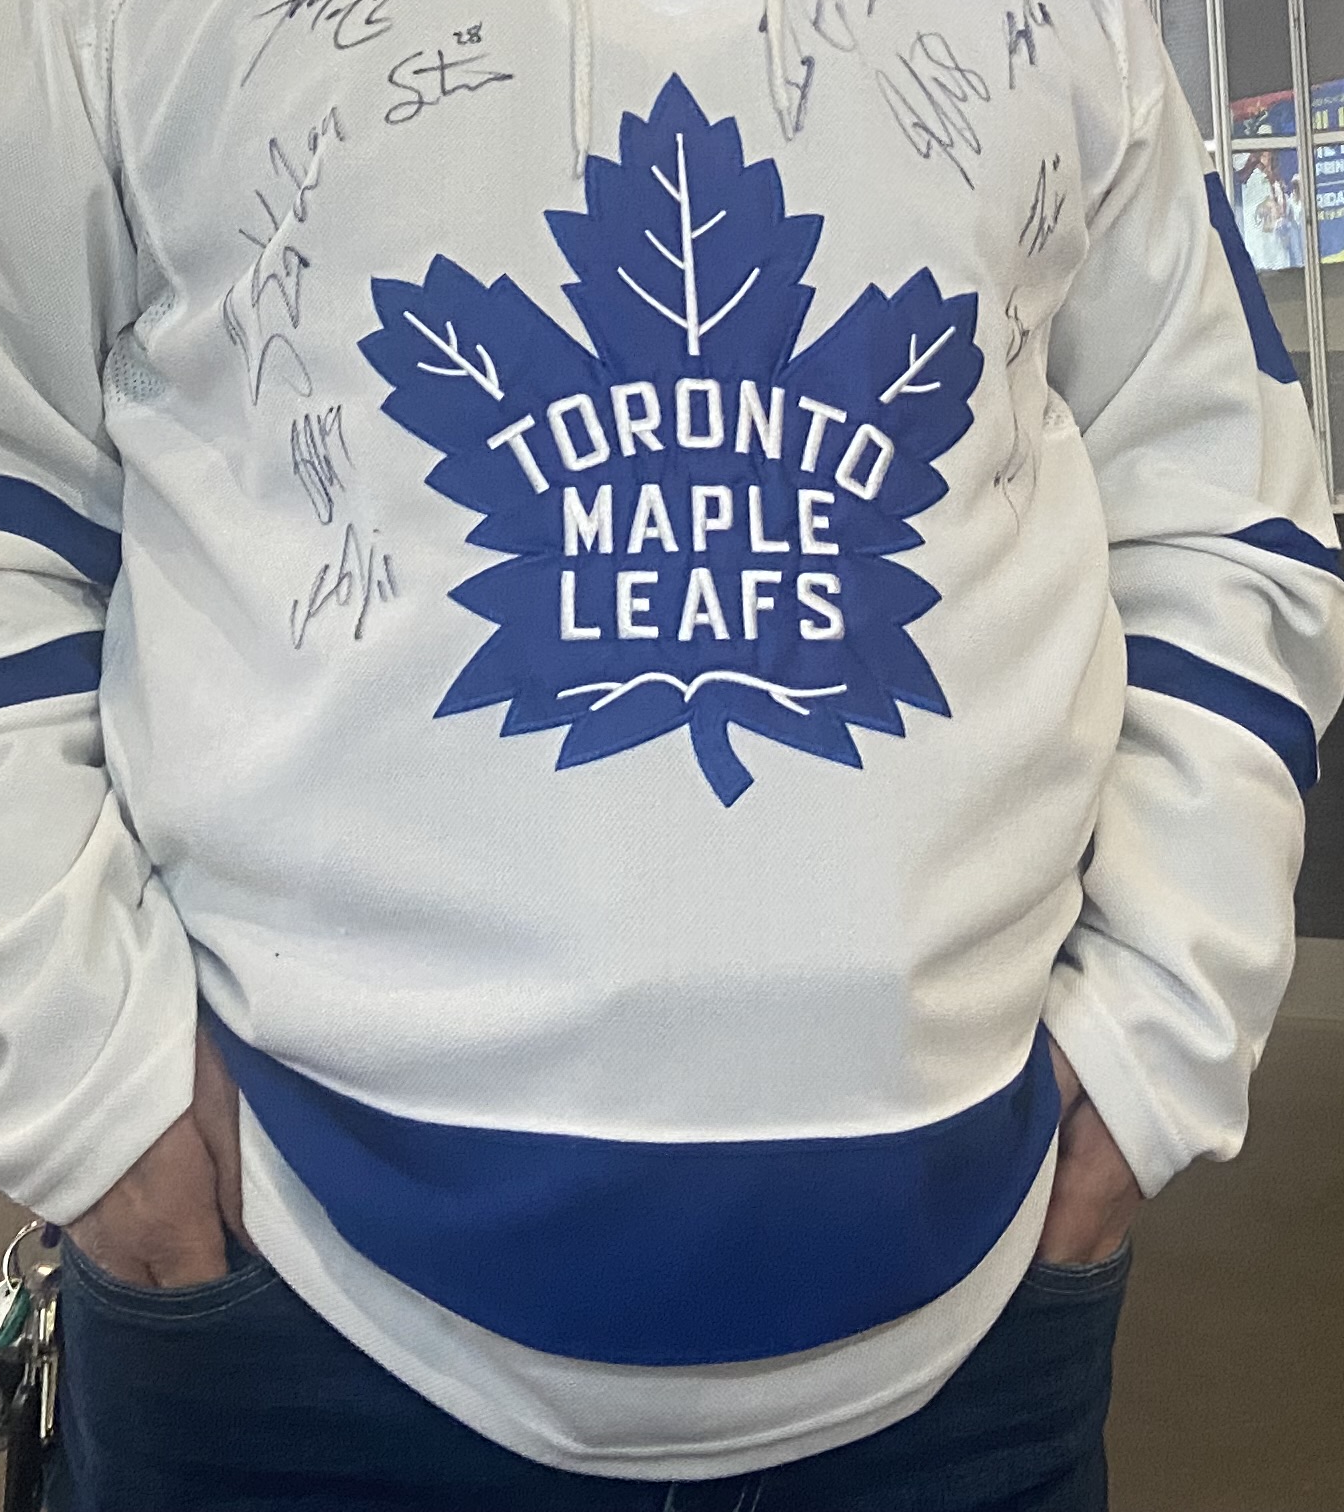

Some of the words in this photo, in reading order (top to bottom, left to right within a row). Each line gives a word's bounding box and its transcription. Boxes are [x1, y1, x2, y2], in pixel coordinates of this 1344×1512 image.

[487, 377, 894, 500] TORONTO
[563, 484, 839, 556] MAPLE
[560, 567, 846, 642] LEAFS
